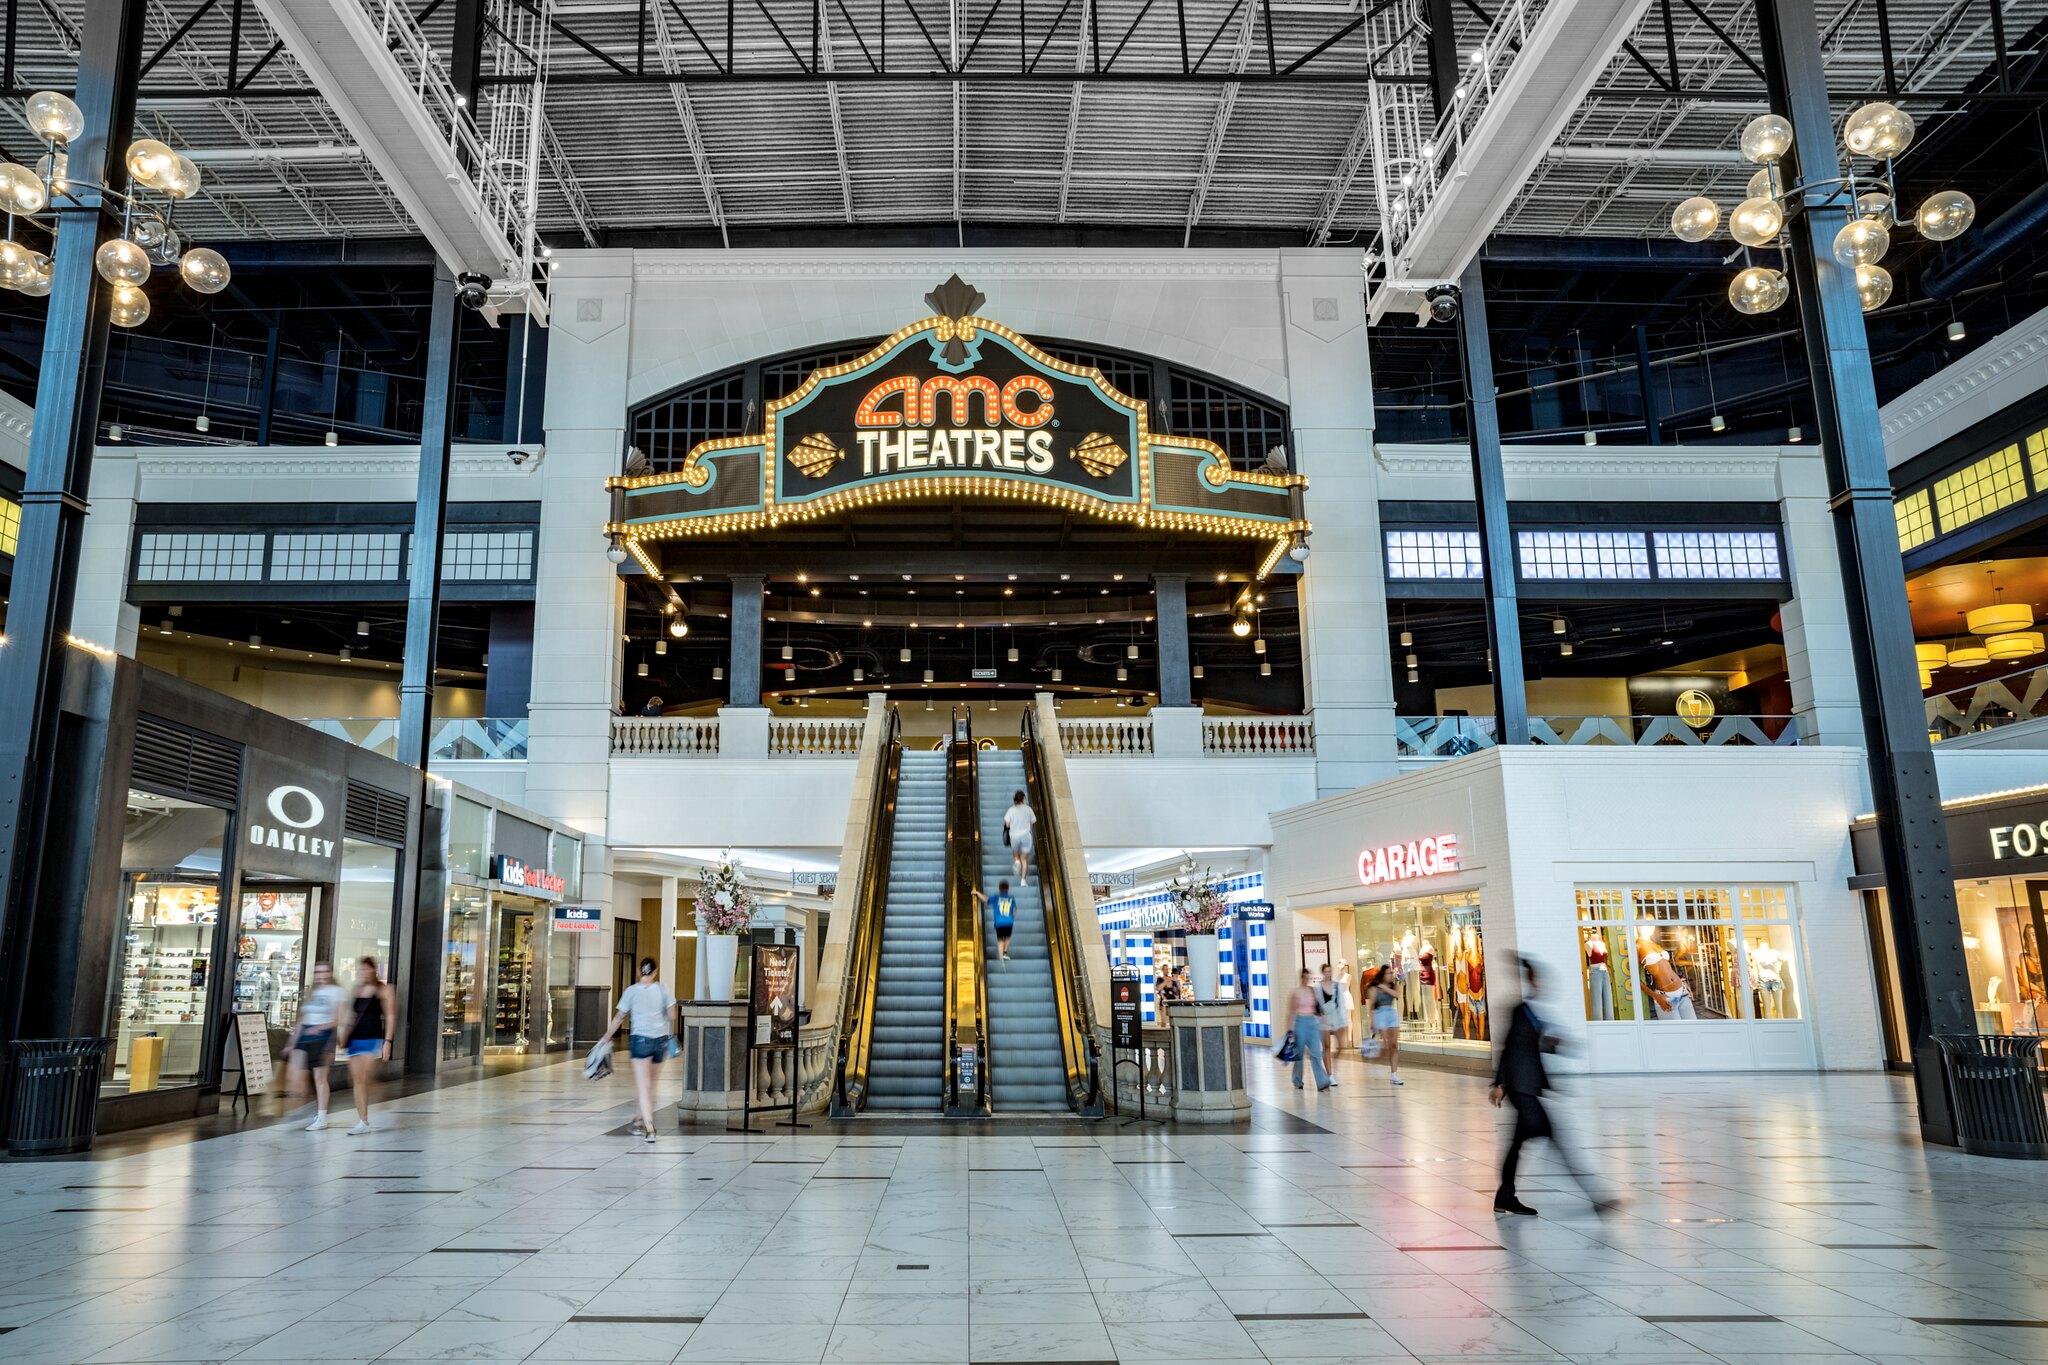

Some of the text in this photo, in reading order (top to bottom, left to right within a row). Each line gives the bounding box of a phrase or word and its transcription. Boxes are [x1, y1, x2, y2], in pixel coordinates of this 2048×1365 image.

[856, 430, 1054, 475] THEATRES
[250, 825, 335, 858] OAKLEY
[1358, 834, 1457, 886] GARAGE
[503, 857, 525, 886] kids
[797, 872, 817, 884] GUEST
[1101, 873, 1131, 885] SERVICES
[566, 908, 589, 919] kids
[769, 957, 787, 967] Need
[763, 967, 790, 977] Tickets?
